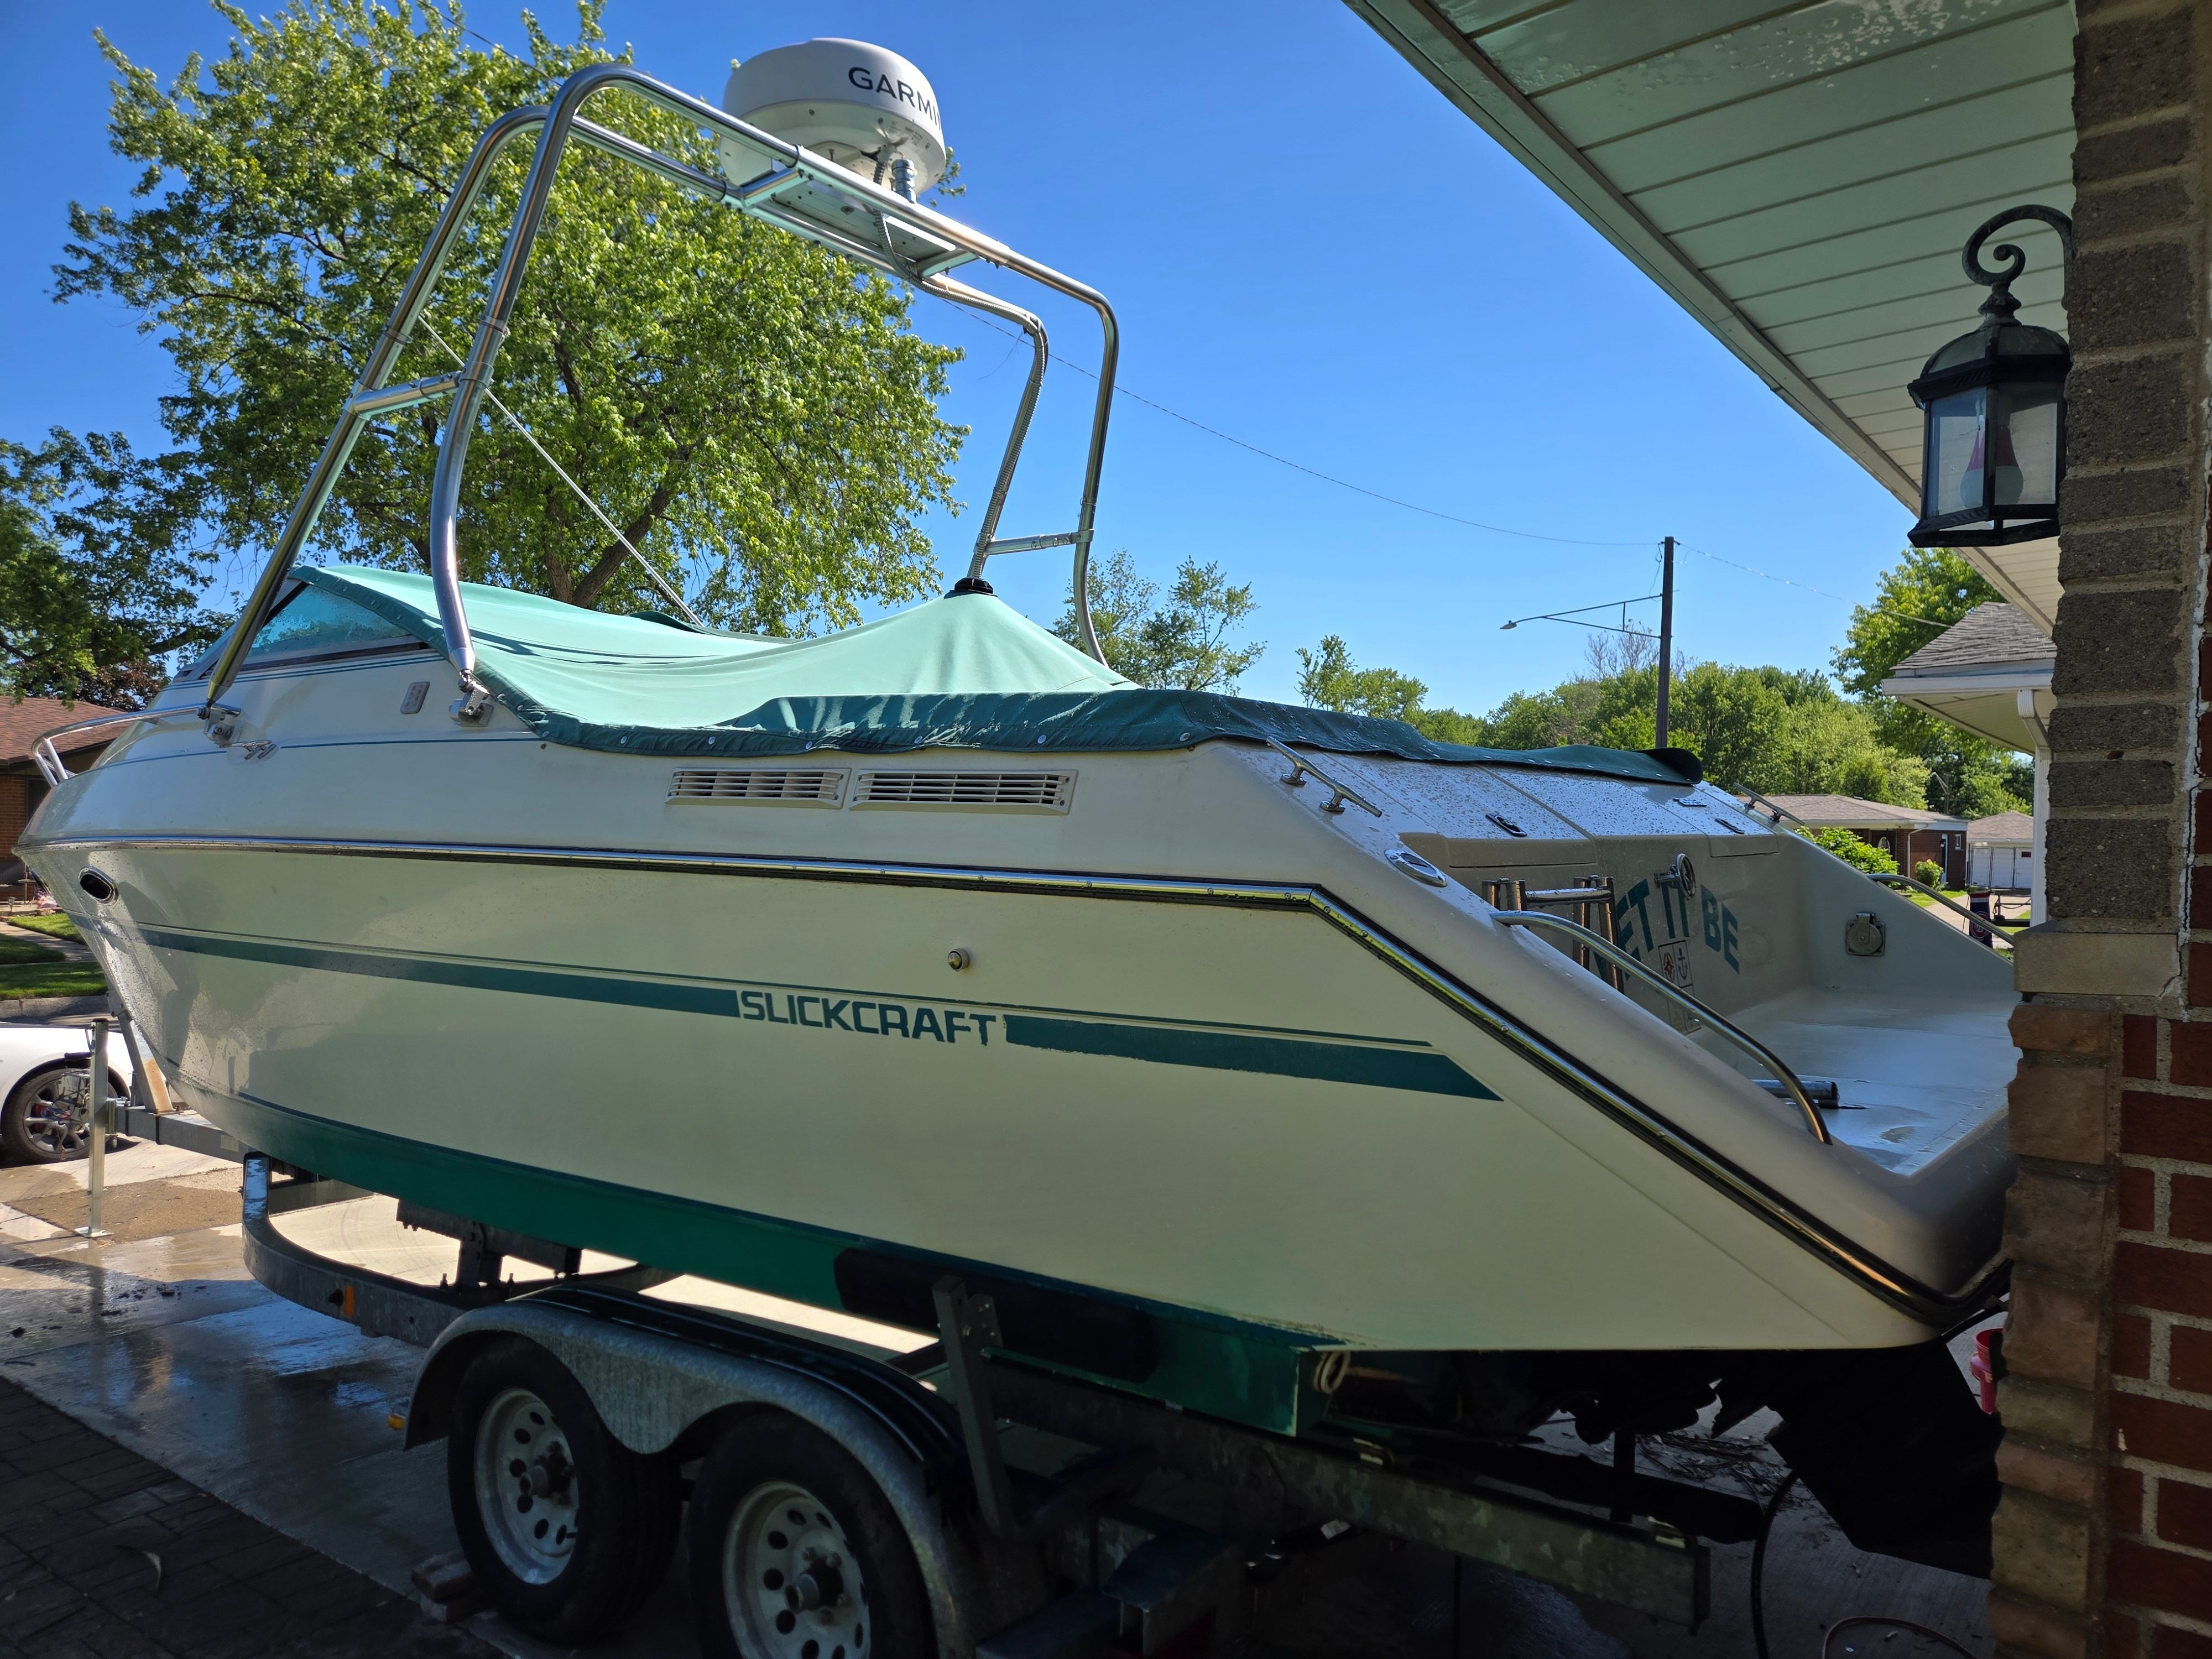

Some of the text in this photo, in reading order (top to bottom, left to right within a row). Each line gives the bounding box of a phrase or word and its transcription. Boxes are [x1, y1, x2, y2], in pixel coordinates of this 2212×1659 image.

[1593, 878, 1654, 982] ET
[1700, 884, 1740, 975] BE
[740, 990, 997, 1046] SLICKCRAFT
